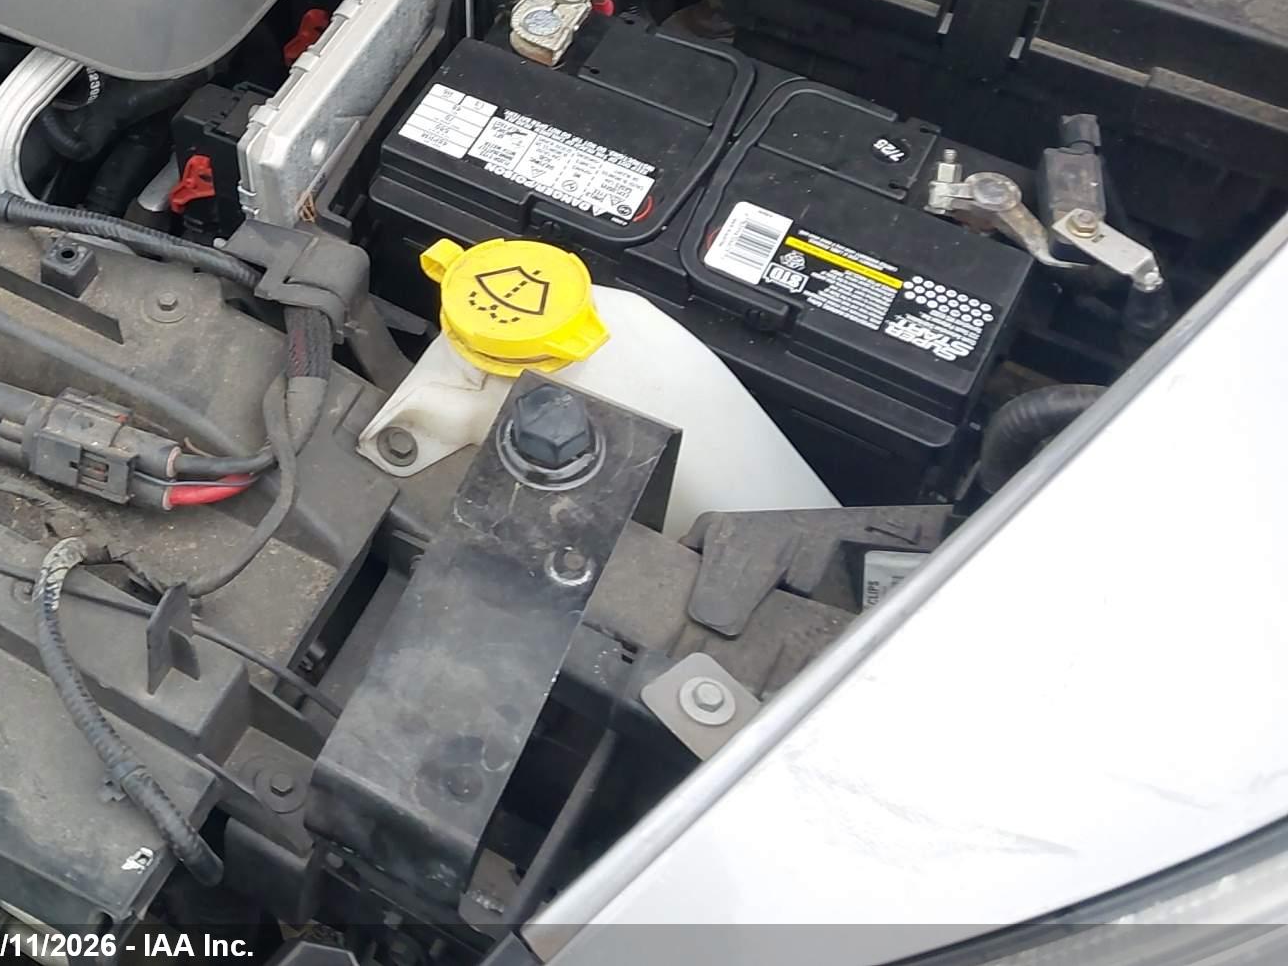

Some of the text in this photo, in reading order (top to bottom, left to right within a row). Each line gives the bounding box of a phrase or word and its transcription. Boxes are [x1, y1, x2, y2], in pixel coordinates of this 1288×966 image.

[482, 161, 592, 212] DANGER/POISON
[882, 323, 958, 362] SUPER
[885, 317, 976, 358] START
